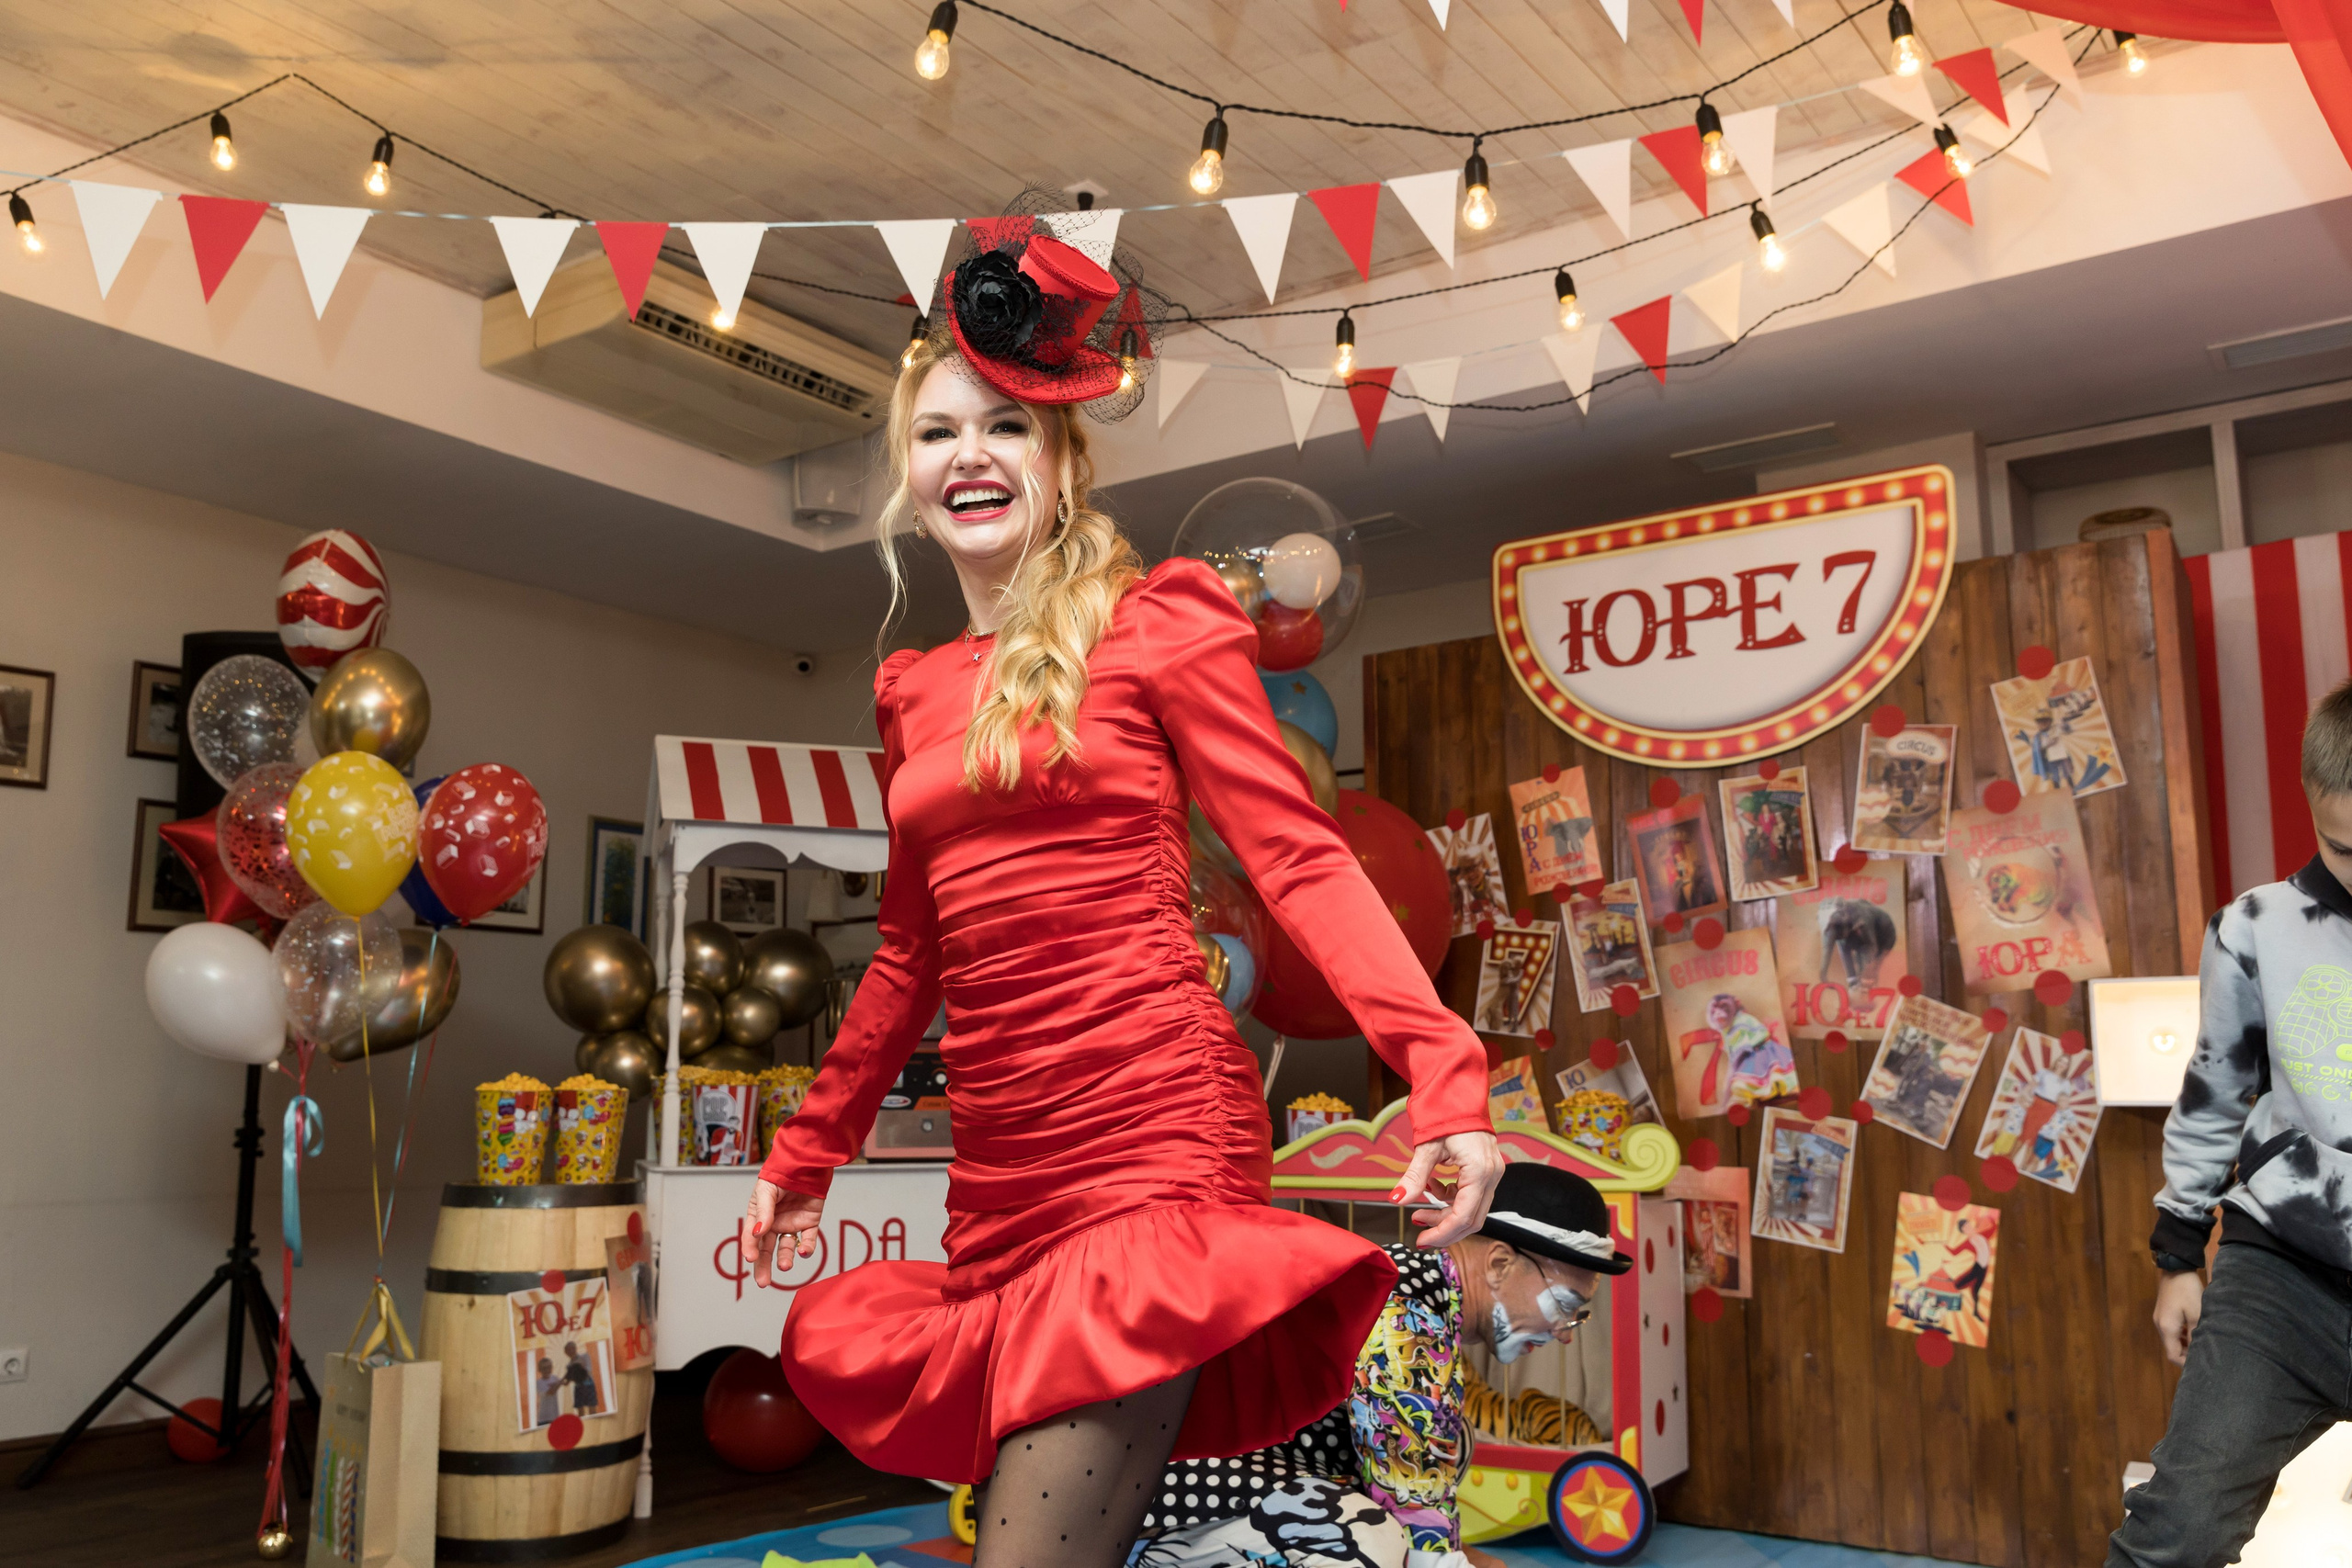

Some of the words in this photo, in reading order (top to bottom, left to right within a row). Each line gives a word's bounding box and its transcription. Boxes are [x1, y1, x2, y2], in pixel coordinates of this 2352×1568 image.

[1823, 549, 1876, 634] 7
[1896, 739, 1936, 756] CIRCUS
[1668, 949, 1759, 990] CIRCUS
[1975, 930, 2093, 980] ЮРА
[1679, 1028, 1725, 1106] 7
[702, 1096, 729, 1112] POP
[577, 1296, 597, 1328] 7
